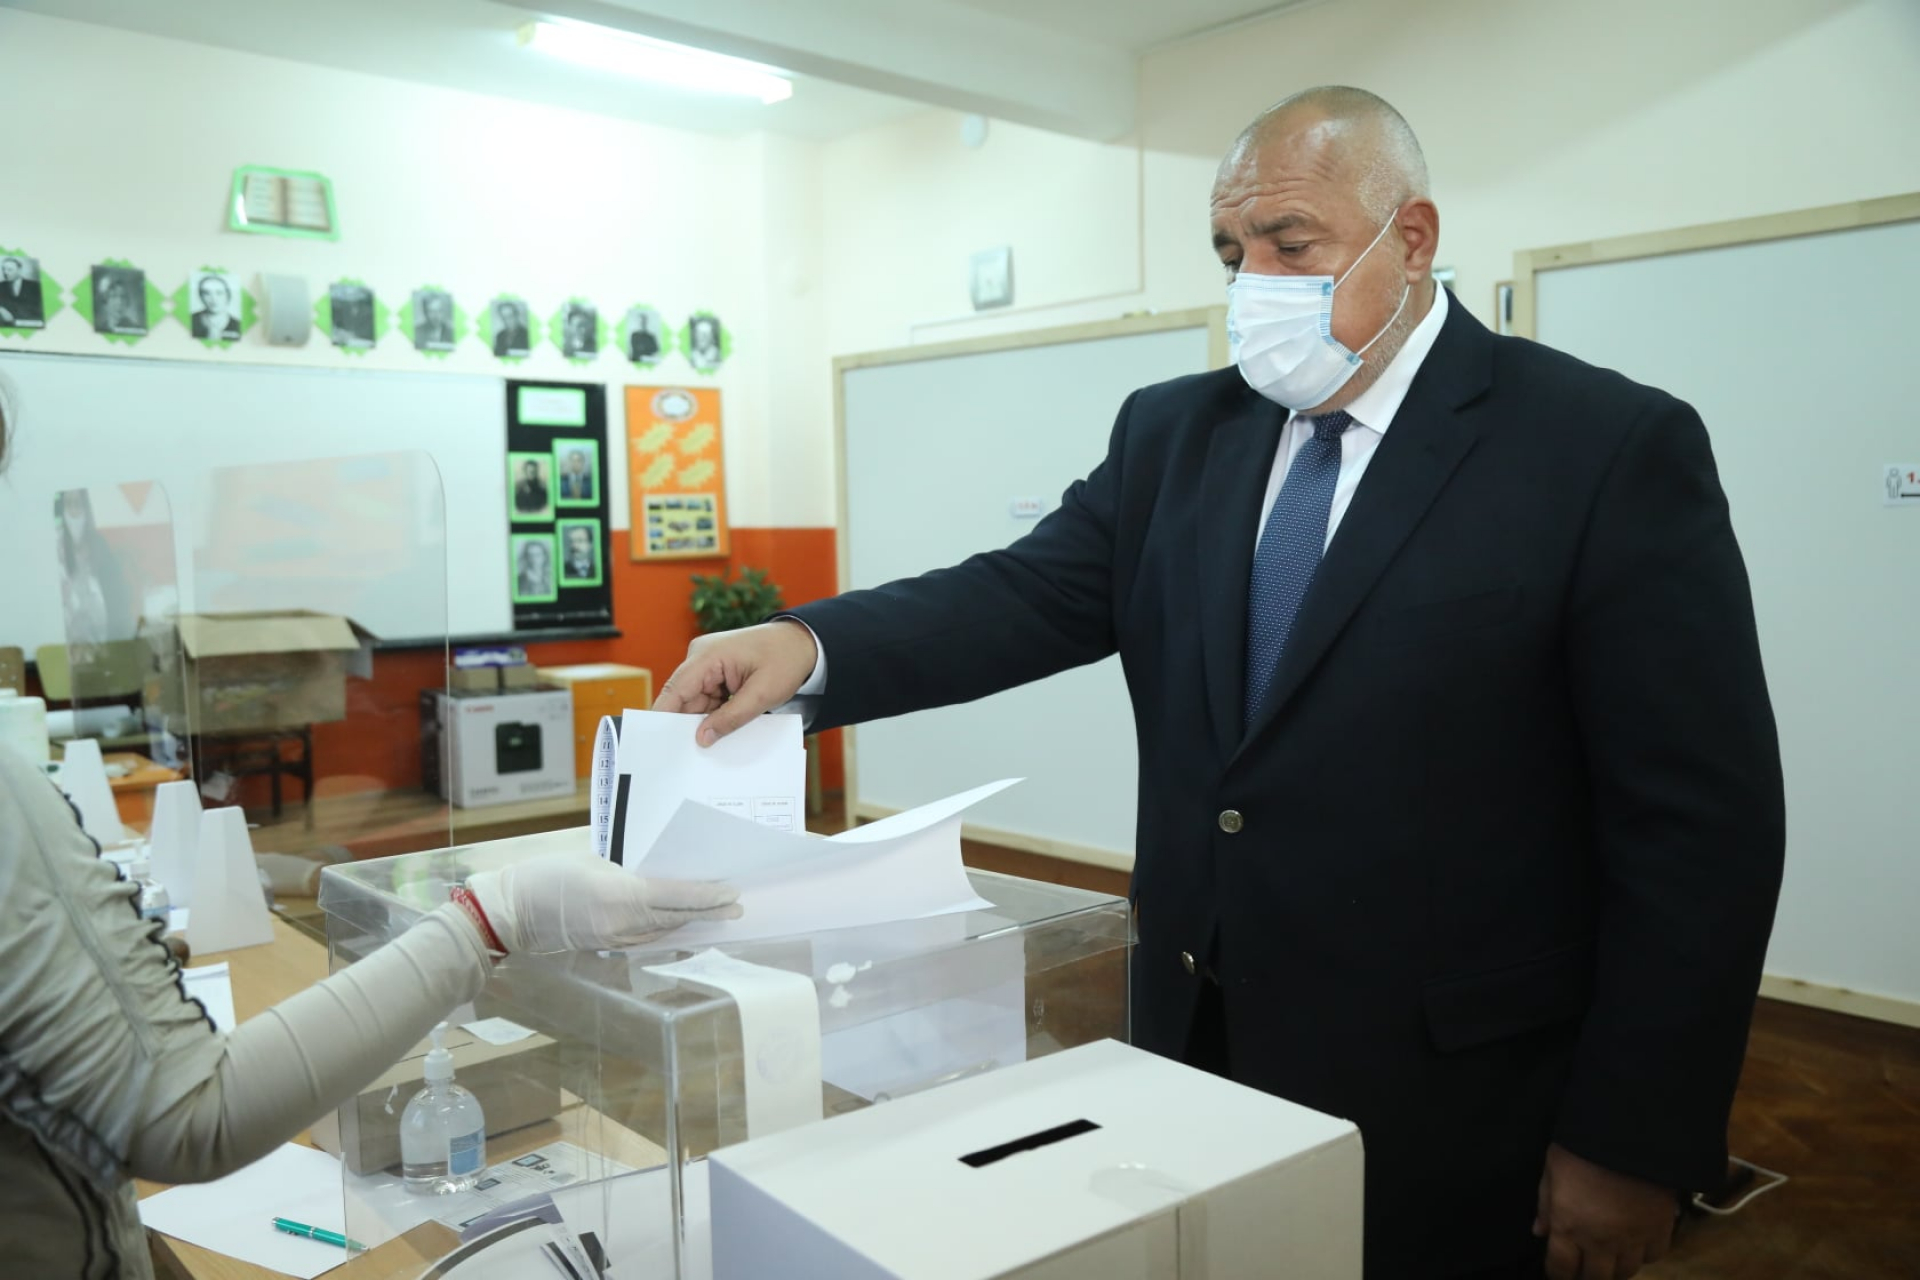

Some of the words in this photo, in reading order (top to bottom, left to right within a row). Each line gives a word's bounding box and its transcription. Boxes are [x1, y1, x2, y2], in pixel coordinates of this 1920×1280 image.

[600, 759, 610, 769] 12
[600, 777, 609, 787] 13
[600, 796, 609, 806] 14
[600, 815, 610, 824] 15
